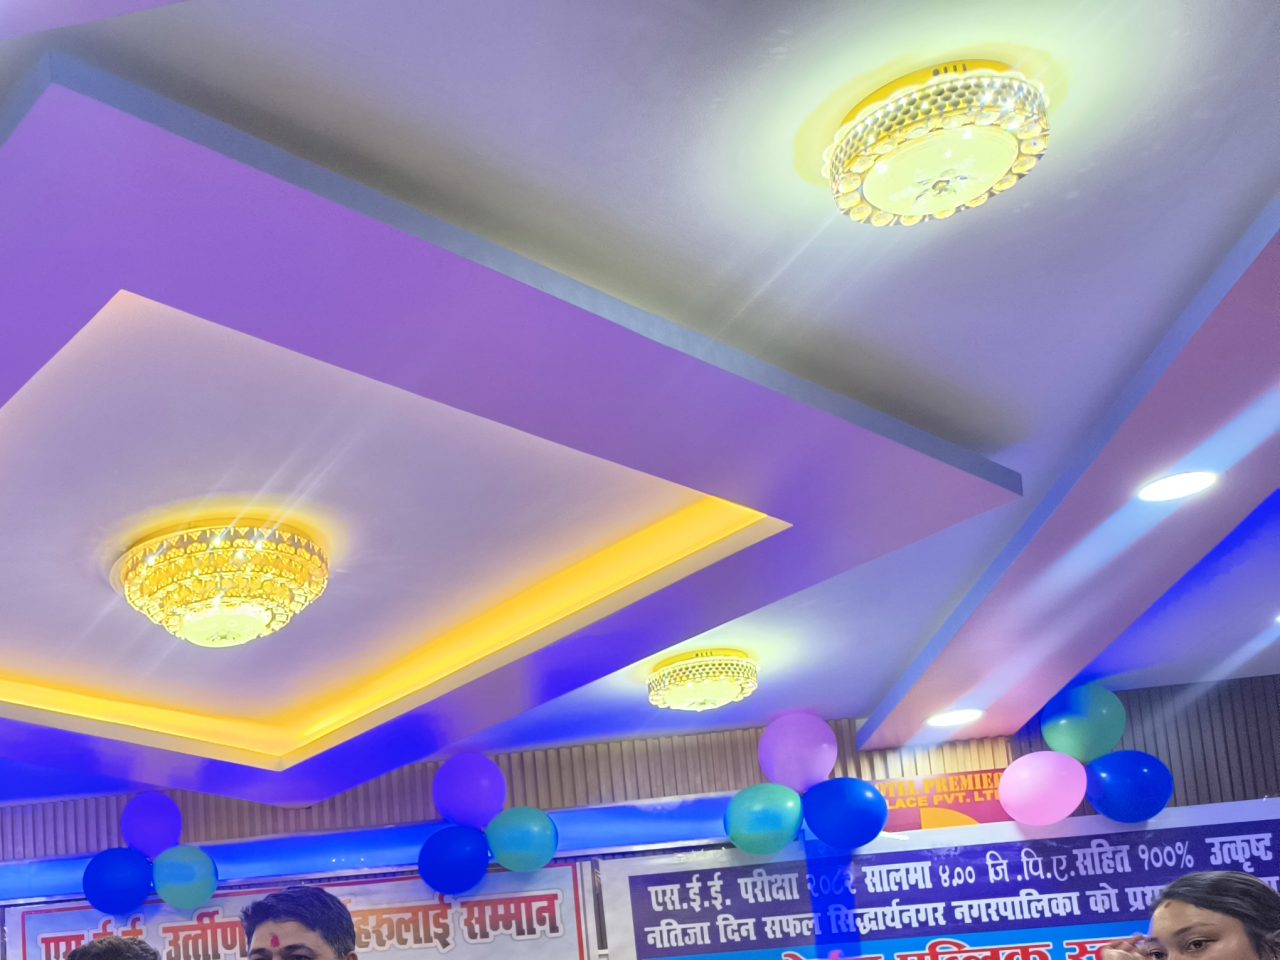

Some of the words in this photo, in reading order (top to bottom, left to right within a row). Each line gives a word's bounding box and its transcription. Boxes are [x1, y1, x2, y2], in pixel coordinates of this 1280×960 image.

[887, 796, 929, 810] LACE
[933, 792, 971, 806] PVT.
[648, 872, 731, 912] एस.ई.ई.
[737, 868, 799, 903] परीक्षा
[862, 861, 933, 893] सालमा
[1138, 840, 1195, 871] १००%
[1205, 833, 1273, 873] उत्कृष्ट
[347, 892, 452, 949] हरुलाई
[461, 893, 560, 940] सम्मान
[644, 919, 711, 949] नतिजा
[716, 914, 757, 943] दिन
[762, 912, 822, 939] सफल
[828, 899, 947, 935] सिद्धार्थनगर
[951, 888, 1082, 924] नगरपालिका
[1086, 883, 1120, 913] को
